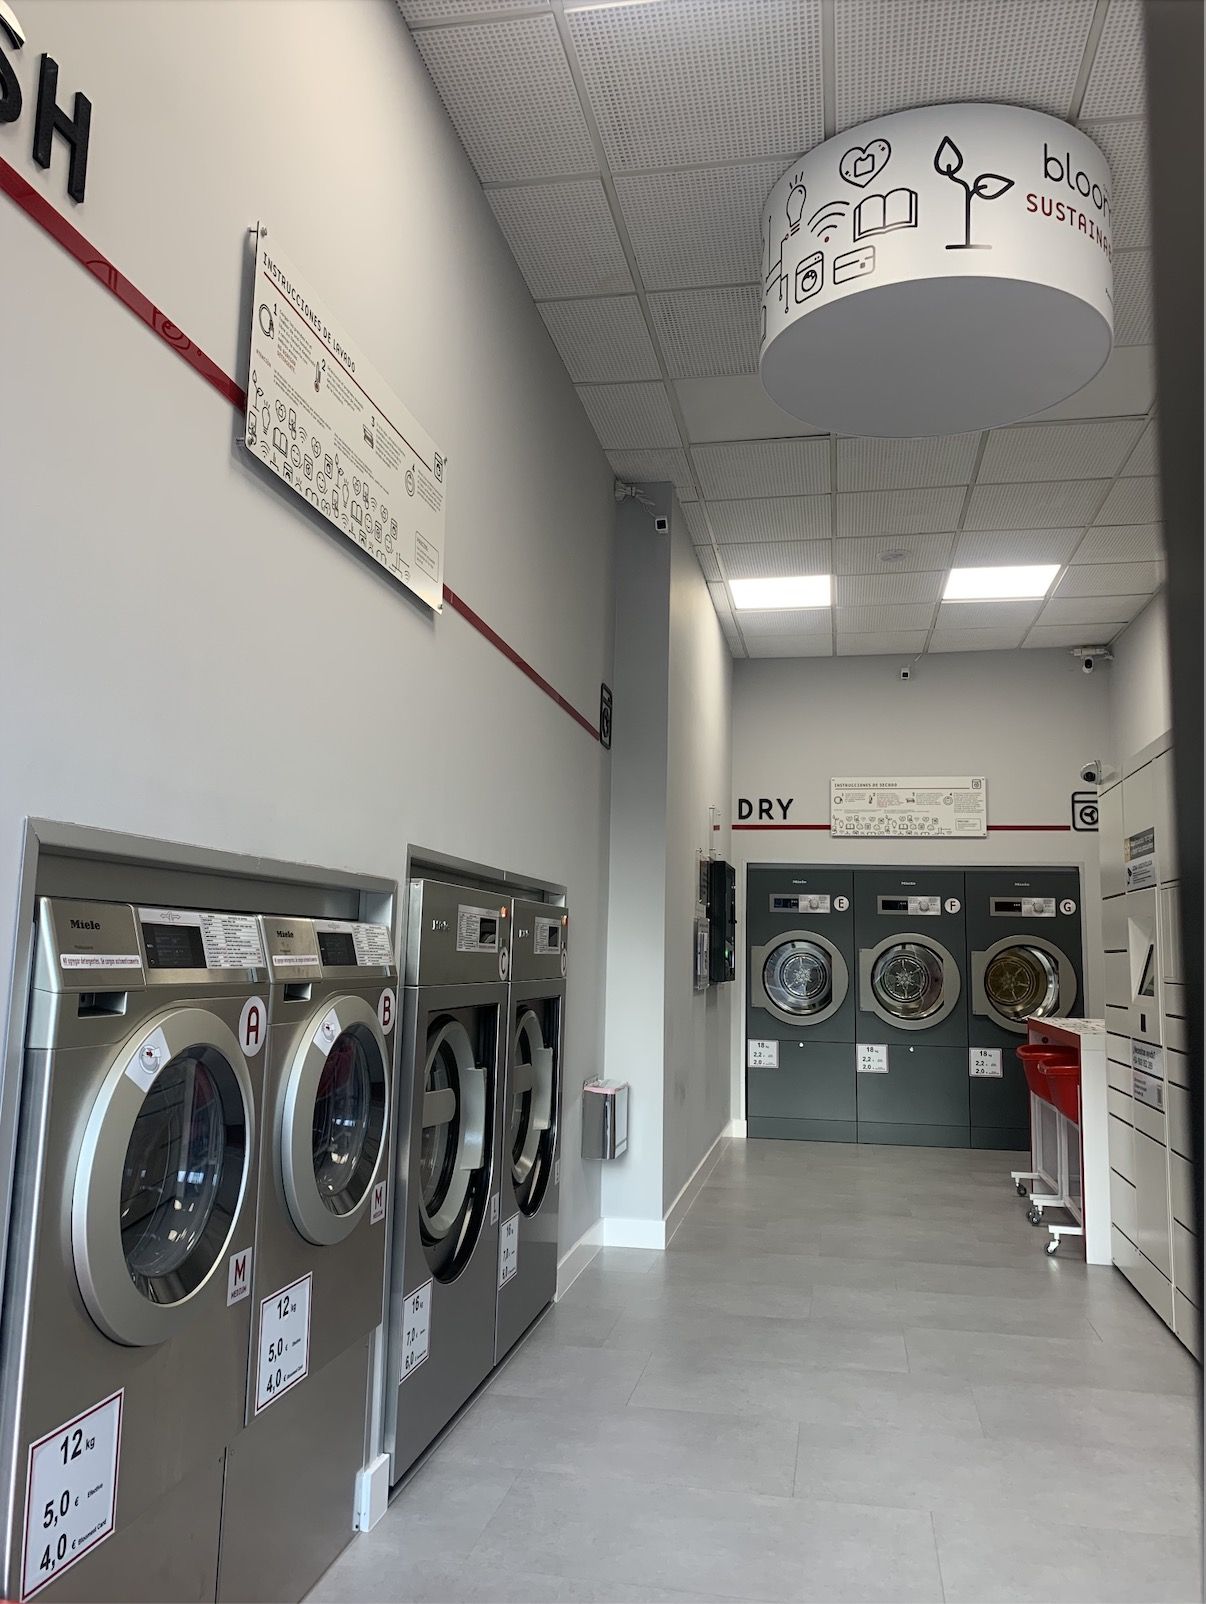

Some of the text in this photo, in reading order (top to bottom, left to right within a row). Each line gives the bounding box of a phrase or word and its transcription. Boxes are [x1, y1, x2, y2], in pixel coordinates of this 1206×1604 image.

[263, 252, 322, 331] INSTRUCCIONES
[323, 326, 331, 343] DE
[332, 339, 356, 373] LAVADO
[321, 358, 326, 372] 2
[738, 798, 794, 820] DRY
[838, 899, 844, 908] E
[950, 900, 956, 911] F
[1063, 902, 1072, 912] G
[70, 919, 101, 930] Miele
[276, 930, 294, 939] Miele
[382, 996, 391, 1026] B
[246, 1005, 259, 1046] A
[374, 1186, 383, 1210] M
[234, 1255, 246, 1286] M
[230, 1285, 247, 1299] MEDIUM
[277, 1295, 297, 1321] 12 kg
[406, 1327, 415, 1347] 7,0
[268, 1337, 283, 1363] 5,0
[405, 1351, 415, 1370] 6,0
[266, 1368, 282, 1394] 4,0
[60, 1428, 96, 1465] 12 kg
[43, 1489, 70, 1529] 5,0
[74, 1496, 79, 1507] €
[39, 1533, 67, 1571] 4,0
[71, 1539, 76, 1550] €
